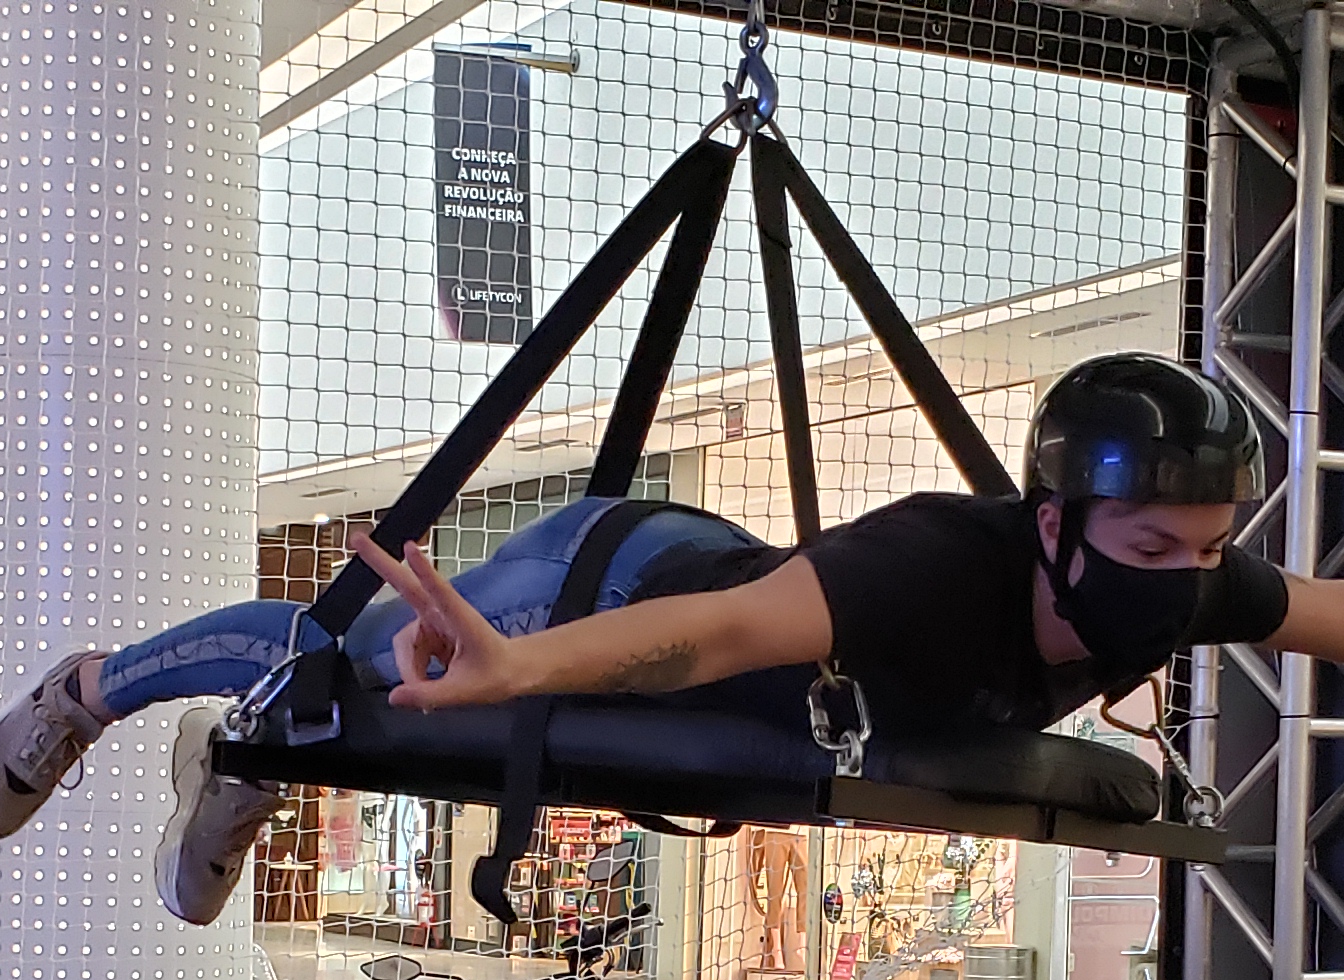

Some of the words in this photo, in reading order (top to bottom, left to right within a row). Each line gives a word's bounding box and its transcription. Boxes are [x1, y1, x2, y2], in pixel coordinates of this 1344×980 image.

[451, 147, 516, 167] CONHEÇA
[458, 167, 468, 180] A
[470, 168, 511, 184] NOVA
[444, 185, 524, 205] REVOLUÇÃO
[444, 204, 525, 223] FINANCEIRA
